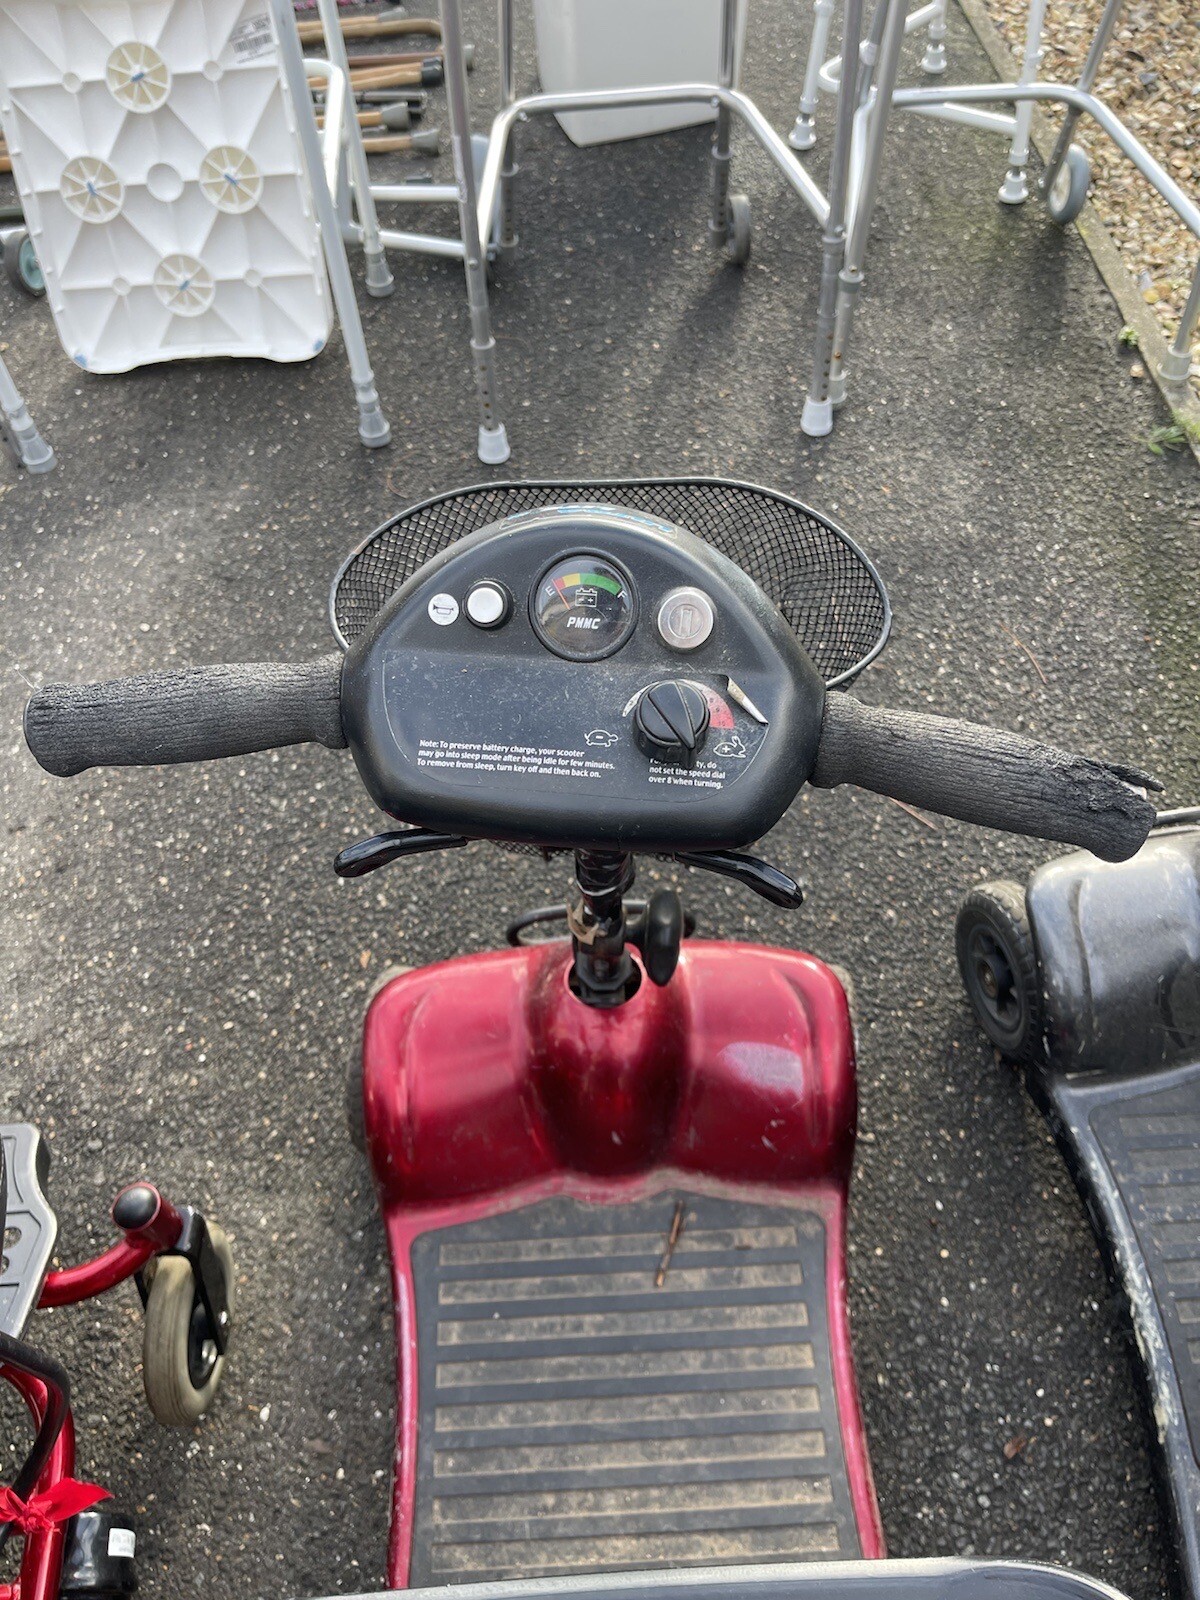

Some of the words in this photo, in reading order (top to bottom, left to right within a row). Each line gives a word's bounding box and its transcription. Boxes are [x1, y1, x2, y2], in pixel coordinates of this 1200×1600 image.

[545, 586, 555, 596] E
[617, 590, 628, 599] F
[566, 616, 600, 630] PMMC
[449, 742, 480, 750] preserve
[482, 744, 510, 752] battery
[510, 746, 537, 754] charge,
[461, 752, 480, 760] sleep
[481, 753, 502, 761] mode
[522, 756, 542, 764] being
[585, 761, 615, 769] minutes.
[456, 761, 473, 769] from
[474, 762, 495, 771] sleep,
[514, 765, 527, 773] key
[571, 769, 589, 777] back
[694, 779, 723, 790] turning.
